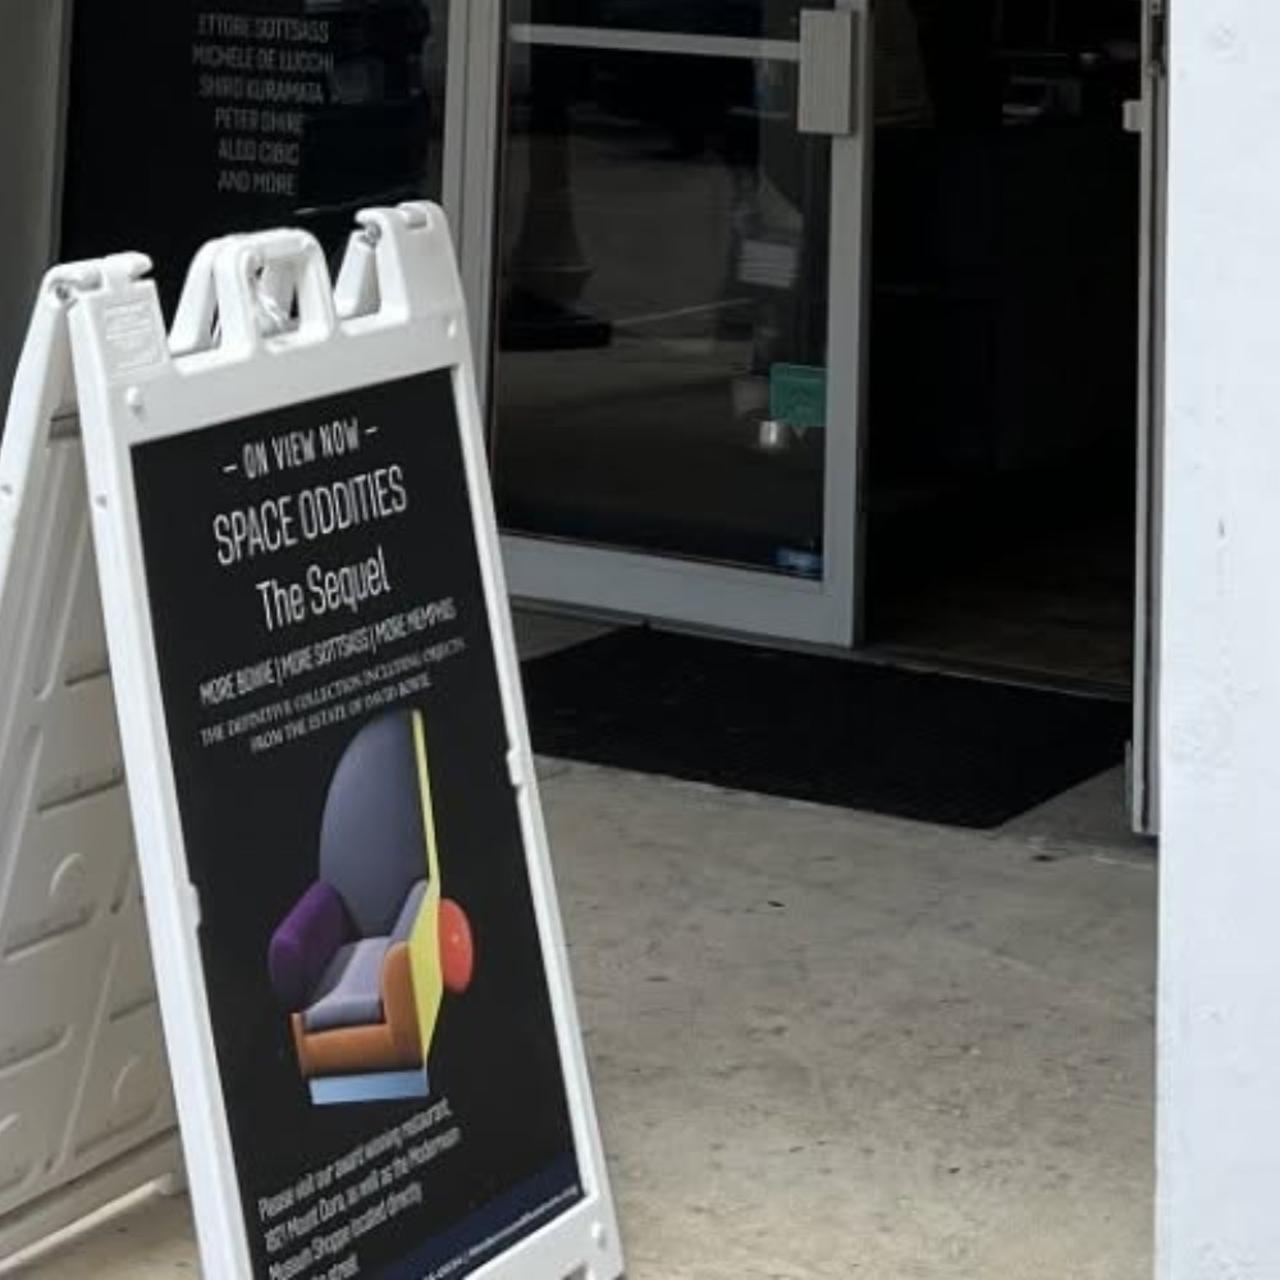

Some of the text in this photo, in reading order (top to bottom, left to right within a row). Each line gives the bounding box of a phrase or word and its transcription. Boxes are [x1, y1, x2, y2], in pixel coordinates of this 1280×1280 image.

[242, 416, 360, 480] ON VIEW NOW
[212, 464, 408, 566] SPACE ODDITIES
[255, 544, 392, 633] The Sequel
